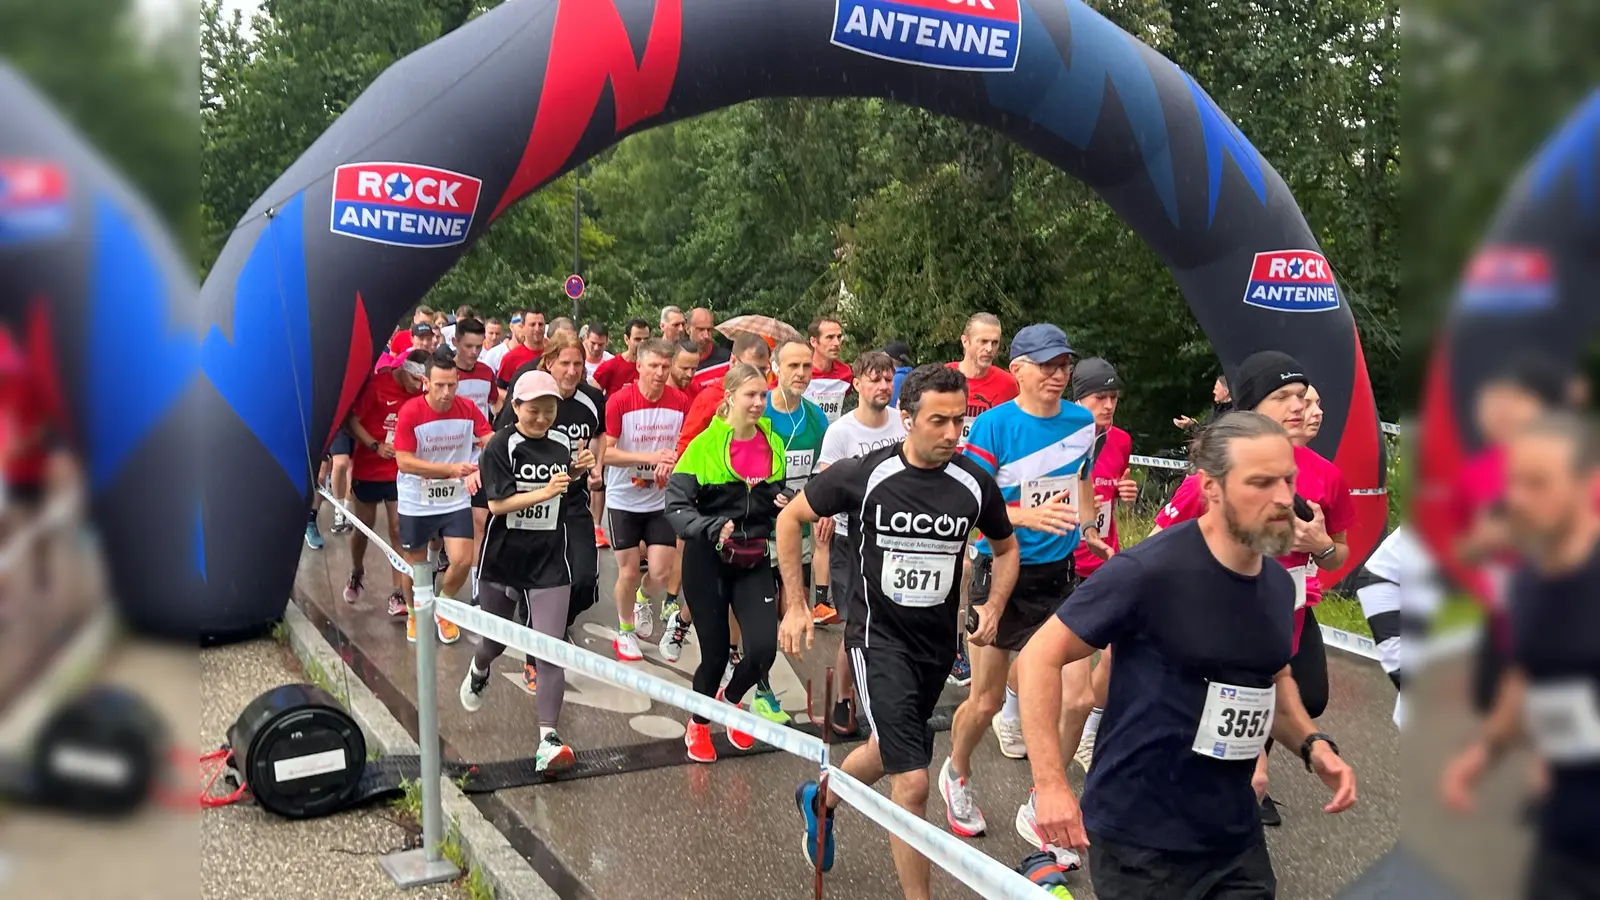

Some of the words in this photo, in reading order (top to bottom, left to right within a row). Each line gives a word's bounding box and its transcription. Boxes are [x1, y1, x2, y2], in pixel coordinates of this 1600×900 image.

[843, 5, 1010, 58] ANTENNE
[358, 171, 462, 208] ROCK
[340, 206, 466, 237] ANTENNE
[1268, 257, 1327, 280] ROCK
[1251, 284, 1336, 302] ANTENNE
[786, 455, 811, 467] PEIQ
[428, 486, 456, 499] 3067
[516, 505, 551, 519] 3681
[875, 504, 969, 537] Lacon
[893, 568, 941, 591] 3671
[1217, 707, 1271, 738] 3552
